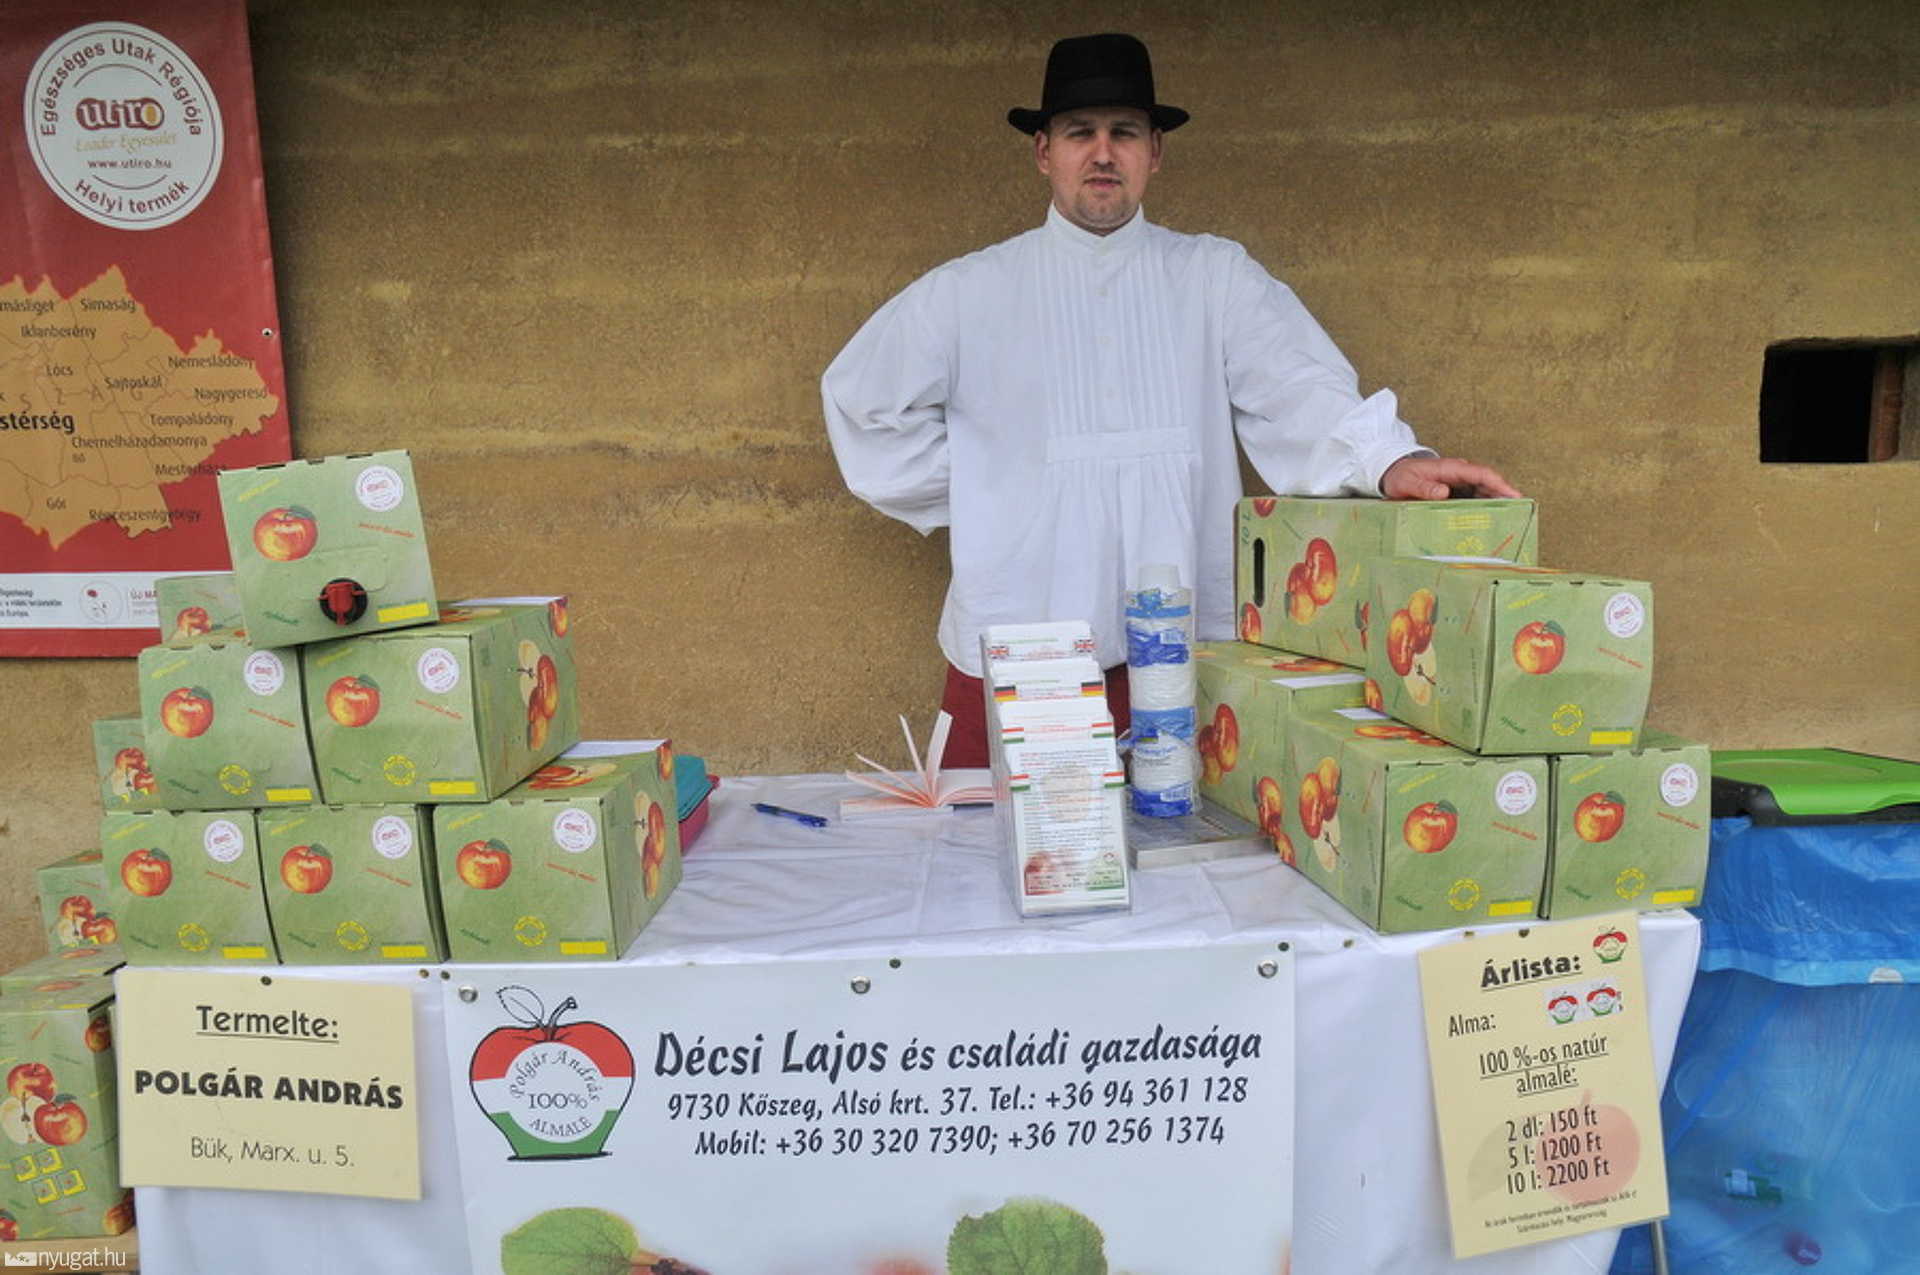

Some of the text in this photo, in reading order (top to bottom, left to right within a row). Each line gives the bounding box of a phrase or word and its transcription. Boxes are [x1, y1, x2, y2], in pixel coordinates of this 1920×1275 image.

[40, 37, 202, 136] Egészséges Utak Régiója
[87, 157, 172, 169] www.utiro.hu
[75, 178, 190, 214] Helyi termék
[80, 298, 136, 314] Simaság
[104, 375, 163, 392] Sajtoskál
[1480, 955, 1581, 990] Árlista:
[196, 1004, 340, 1040] Termelte:
[1448, 1013, 1497, 1038] Alma:
[654, 1022, 1263, 1085] Décsi Lajos és családi gazdasága
[1479, 1032, 1609, 1077] 100 %-os natúr
[134, 1067, 405, 1111] POLGÁR ANDRÁS
[510, 1050, 603, 1102] Polgár András
[1515, 1064, 1579, 1095] almalé:
[527, 1092, 590, 1111] 100%
[667, 1075, 1249, 1122] 9730 Kőszeg, Alsó krt. 37. Tel.: +36 94 361 128
[694, 1115, 1225, 1156] Mobil: +36 30 320 7390; +36 70 256 1374
[1505, 1119, 1517, 1143] 2
[1522, 1113, 1545, 1140] dl:
[1550, 1108, 1579, 1134] 150
[190, 1136, 356, 1168] Bük, Marx. u. 5.
[1508, 1144, 1519, 1169] 5
[1541, 1134, 1581, 1163] 1200
[1585, 1130, 1603, 1154] Ft
[1505, 1170, 1525, 1196] 10
[1546, 1159, 1590, 1188] 2200
[1593, 1154, 1610, 1178] Ft
